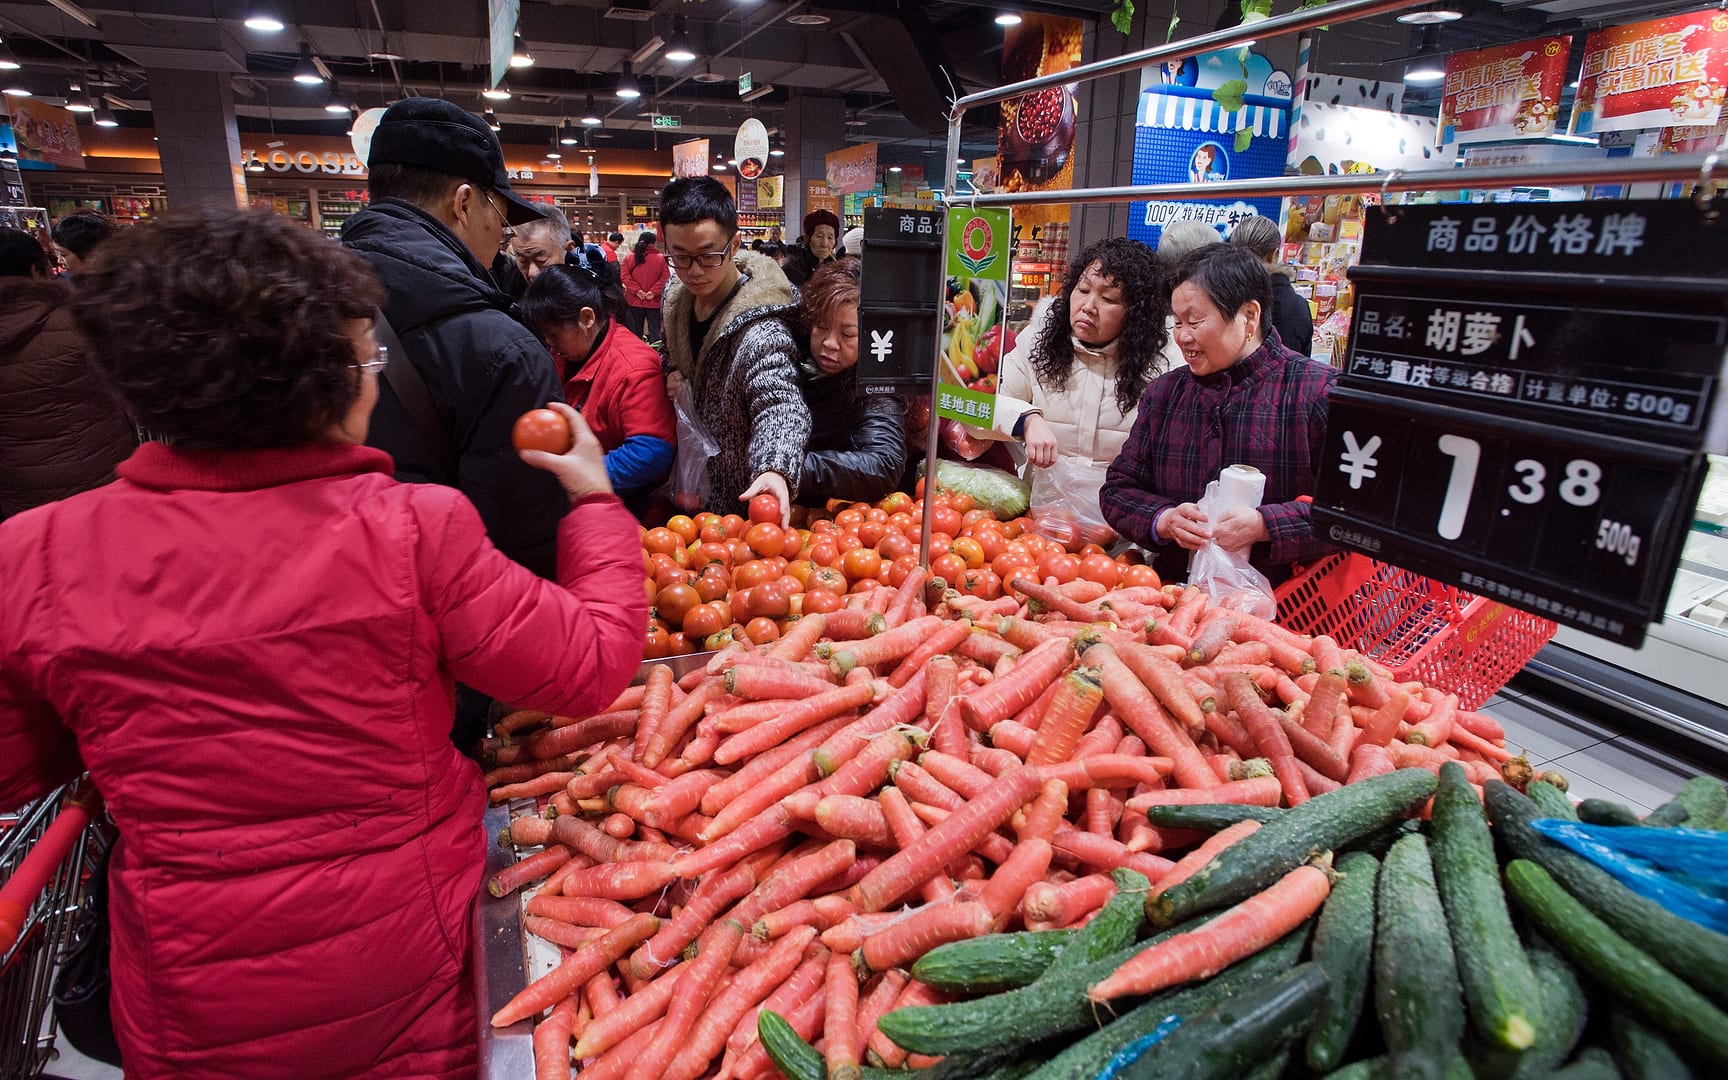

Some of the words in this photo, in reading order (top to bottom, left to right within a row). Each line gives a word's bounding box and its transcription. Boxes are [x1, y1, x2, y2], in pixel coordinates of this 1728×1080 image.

[1446, 54, 1530, 97] 温情暖冬
[1583, 29, 1692, 80] 温情暖冬
[1595, 49, 1709, 98] 实惠放送
[1455, 71, 1543, 114] 实惠放送
[1147, 204, 1180, 230] 100%
[1426, 213, 1648, 256] 商品价格牌
[870, 330, 894, 362] ¥
[1425, 308, 1536, 361] 胡萝卜
[940, 392, 992, 421] 基地直供
[1624, 391, 1691, 424] 500g
[1595, 518, 1641, 567] 500g
